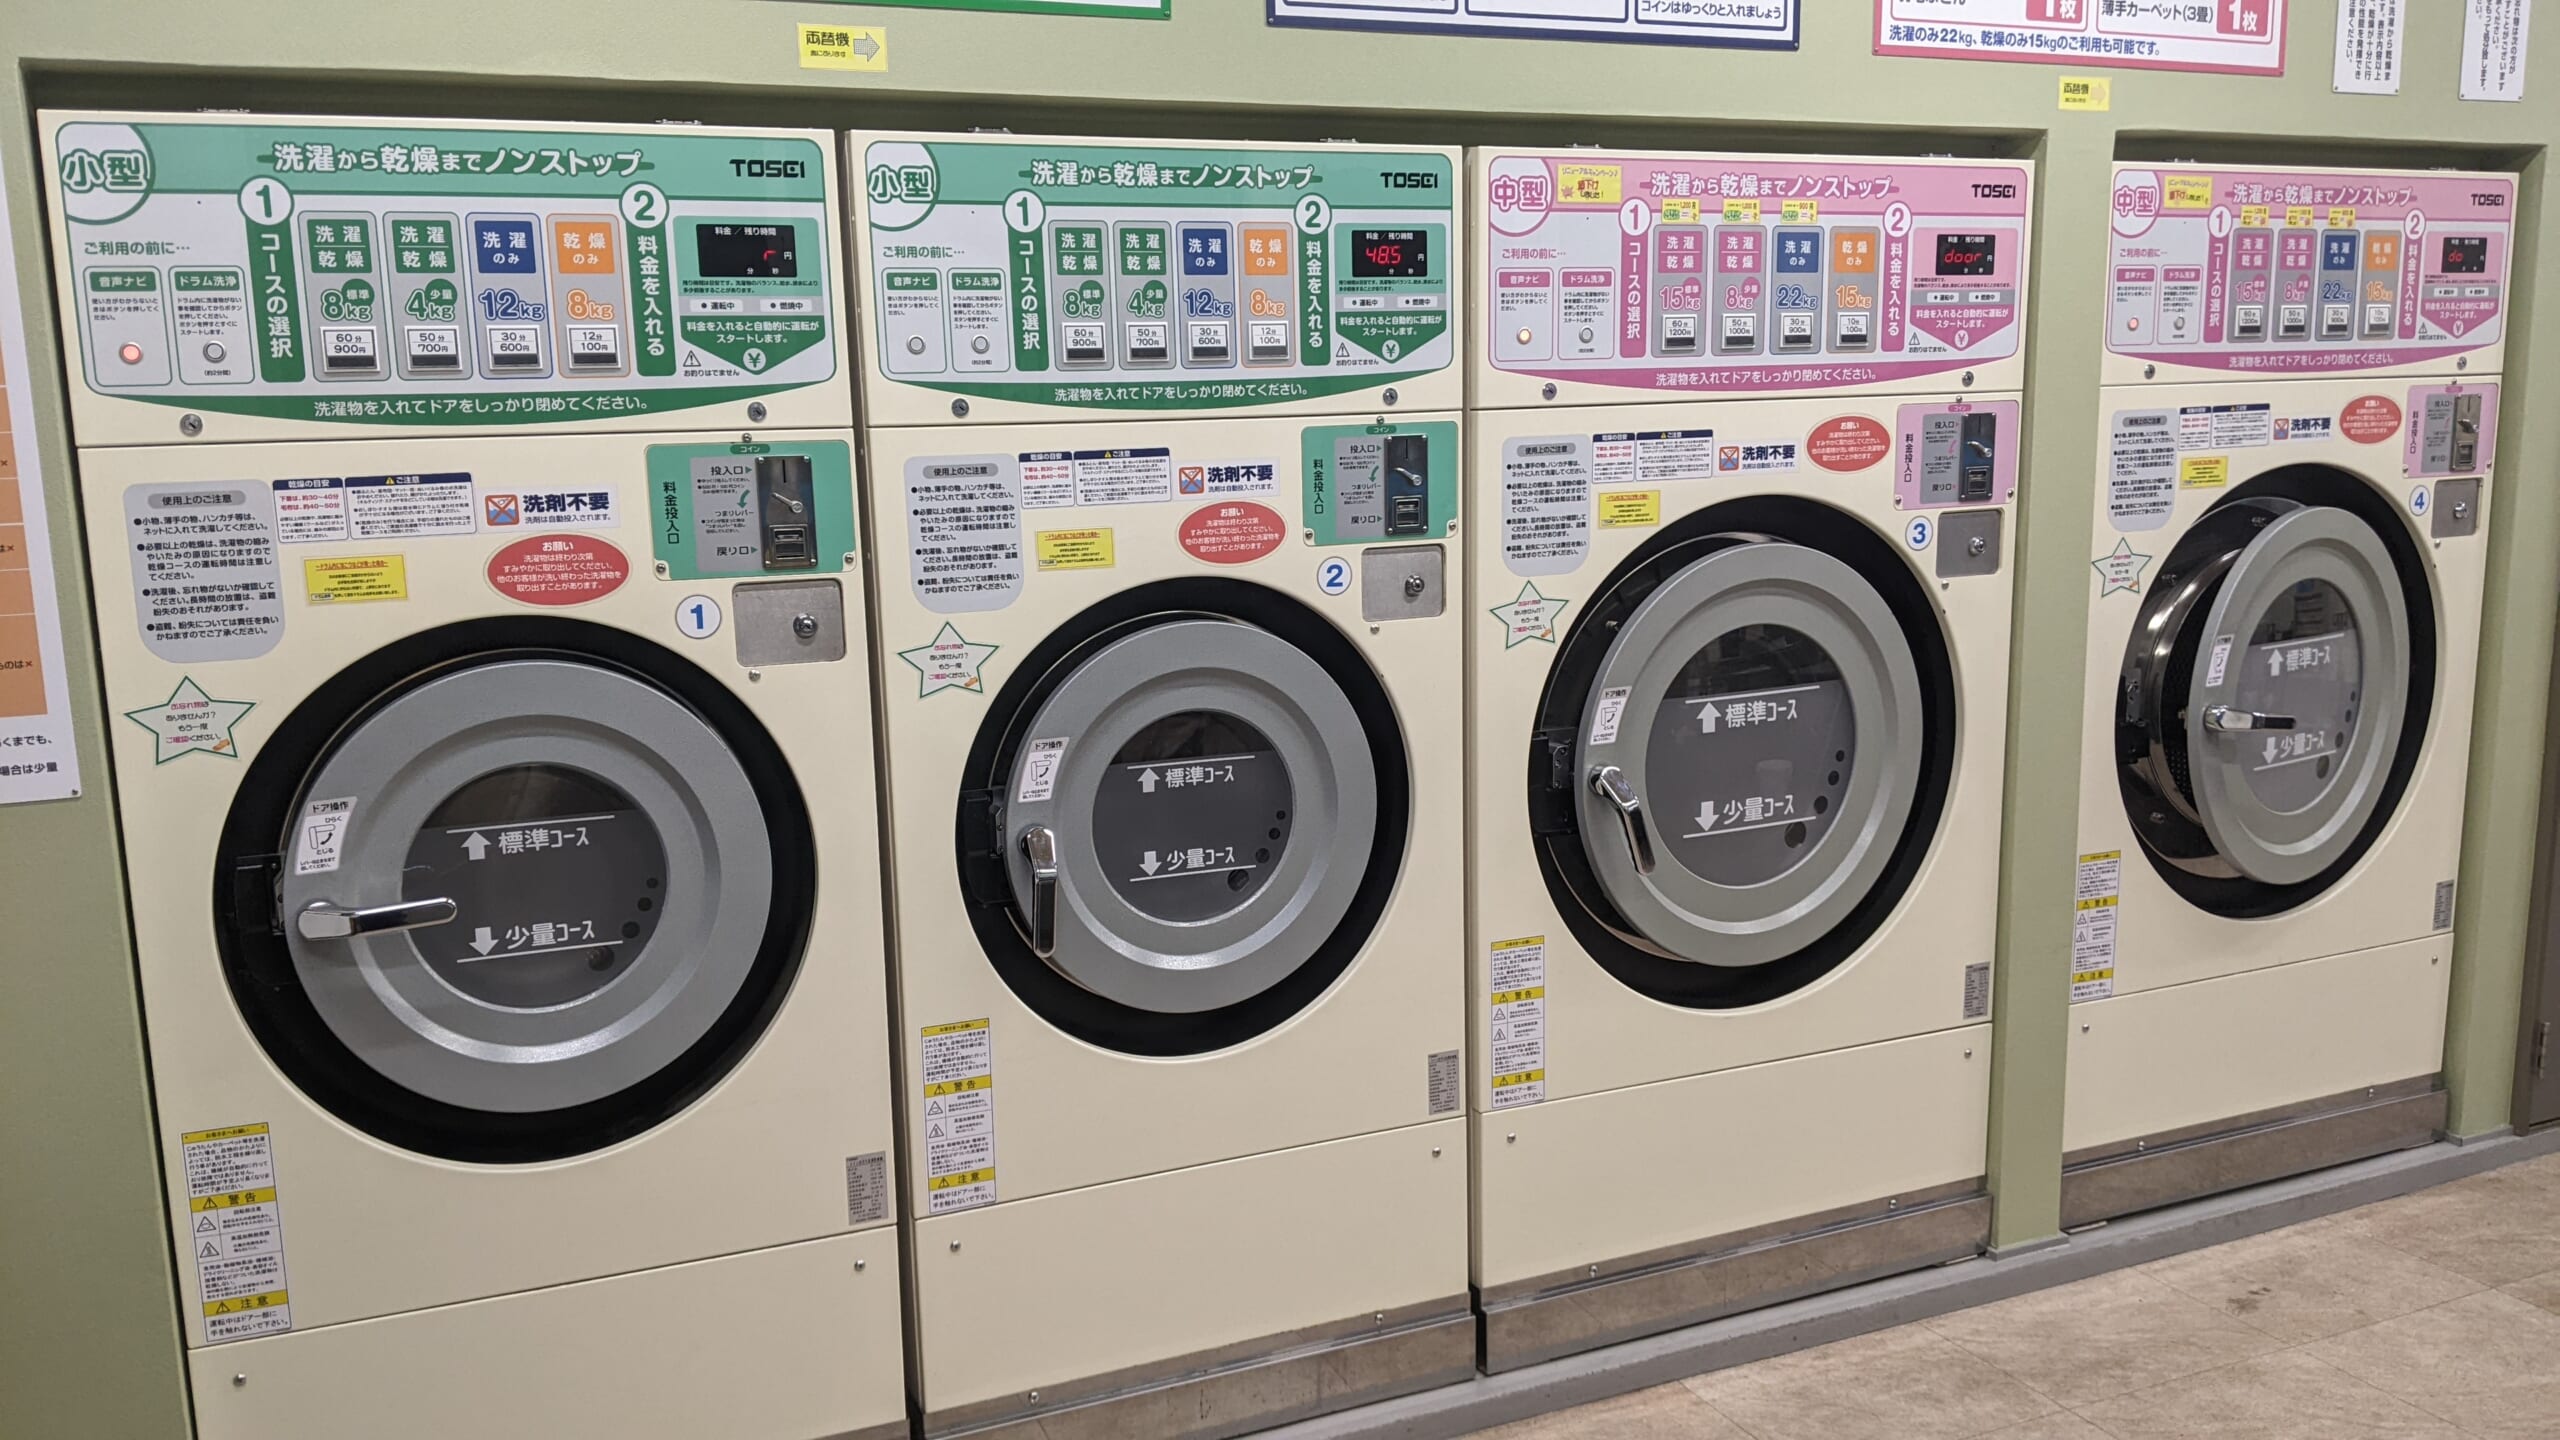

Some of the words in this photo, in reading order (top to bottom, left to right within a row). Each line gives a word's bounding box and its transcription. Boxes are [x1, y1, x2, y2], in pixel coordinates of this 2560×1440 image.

[1642, 1, 1781, 19] コインはゆっくりと入れましょう
[806, 30, 849, 47] 両替機
[1890, 25, 2160, 56] 洗濯のみ22kg、乾燥のみ15kgのご利用も可能です。
[273, 142, 642, 177] 洗濯から乾燥までノンストップ
[730, 159, 806, 178] TOSEI
[62, 150, 147, 192] 小型
[1031, 160, 1315, 189] 洗濯から乾燥までノンストップ
[869, 165, 934, 202] 小型
[1381, 172, 1438, 189] TOSEI
[1651, 172, 1893, 198] 洗濯から乾燥までノンストップ
[1491, 175, 1549, 212] 中型
[1972, 184, 2016, 199] TOSEI
[2232, 184, 2412, 207] 洗濯から乾燥までノンストップ
[2471, 194, 2504, 206] TOSEI
[2115, 185, 2156, 217] 中型
[315, 225, 363, 244] 洗濯
[400, 225, 446, 244] 洗濯
[482, 231, 528, 249] 洗濯
[563, 232, 606, 249] 乾燥
[1061, 233, 1097, 249] 洗濯
[1126, 233, 1160, 249] 洗濯
[1667, 236, 1694, 249] 洗濯
[1727, 236, 1754, 249] 洗濯
[1188, 238, 1222, 253] 洗濯
[1784, 240, 1811, 253] 洗濯
[318, 250, 365, 268] 乾燥
[402, 250, 448, 268] 乾燥
[492, 253, 520, 265] のみ
[572, 253, 600, 265] のみ
[784, 252, 792, 260] 円
[1062, 256, 1098, 270] 乾燥
[1126, 256, 1161, 270] 乾燥
[99, 276, 147, 287] 音声ナビ
[180, 276, 237, 286] ドラム洗浄
[893, 276, 931, 286] 音声ナビ
[954, 276, 1000, 286] ドラム洗浄
[1888, 243, 1902, 336] 料金を入れる
[2209, 243, 2224, 327] コースの選択
[2403, 244, 2418, 326] 料金を入れる
[260, 232, 293, 359] コースの選択
[346, 288, 370, 299] 標準
[430, 288, 453, 299] 少量
[637, 235, 665, 357] 料金を入れる
[1019, 239, 1040, 350] コースの選択
[1306, 241, 1323, 348] 料金を入れる
[1626, 242, 1641, 339] コースの選択
[1660, 286, 1701, 310] 15kg
[1725, 286, 1752, 309] 8kg
[1777, 285, 1818, 309] 22kg
[1836, 286, 1872, 308] 15kg
[321, 289, 373, 322] 8kg
[405, 289, 455, 321] 4kg
[479, 288, 545, 321] 12kg
[567, 289, 615, 320] 8kg
[710, 302, 735, 310] 運転中
[1063, 289, 1102, 318] 8kg
[1128, 289, 1165, 318] 4kg
[1183, 289, 1233, 317] 12kg
[1250, 289, 1285, 317] 8kg
[687, 321, 819, 332] 料金を入れると自動的に運転が
[580, 341, 609, 352] 100円
[716, 333, 788, 344] スタートします。
[1072, 338, 1097, 347] 900円
[1136, 337, 1160, 346] 700円
[1198, 336, 1221, 345] 600円
[1259, 336, 1281, 345] 100円
[334, 344, 366, 355] 900円
[418, 343, 449, 354] 700円
[500, 343, 530, 353] 600円
[1656, 368, 1876, 386] 洗濯物を入れてドアをしっかり閉めてください。
[1054, 383, 1308, 402] 洗濯物を入れてドアをしっかり閉めてください。
[314, 396, 649, 417] 洗濯物を入れてドアをしっかり閉めてください。
[1935, 421, 1954, 429] 投入口
[2291, 417, 2331, 431] 洗剤不要
[1350, 445, 1375, 453] 投入口
[1742, 445, 1796, 462] 洗剤不要
[1904, 433, 1913, 482] 料金投入口
[711, 466, 743, 476] 投入口
[934, 466, 988, 476] 使用上のご注意
[1207, 465, 1273, 483] 洗剤不要
[288, 480, 330, 488] 乾燥の目安
[396, 476, 420, 485] ご注意
[1313, 459, 1324, 514] 料金投入口
[162, 494, 233, 506] 使用上のご注意
[523, 492, 609, 513] 洗剤不要
[2414, 492, 2425, 509] 4
[525, 514, 611, 524] 洗剤は自動投入されます。
[662, 481, 680, 545] 料金投入口
[1220, 508, 1244, 517] お願い
[144, 523, 268, 535] ネットに入れて洗濯してください。
[1913, 523, 1926, 544] 3
[542, 541, 574, 552] お願い
[717, 546, 749, 556] 戻り口
[149, 572, 195, 581] てください。
[1326, 564, 1343, 587] 2
[690, 604, 704, 630] 1
[2286, 646, 2330, 671] 標準コース
[1725, 699, 1798, 729] 標準コース
[178, 723, 209, 732] もう一度
[2280, 731, 2324, 758] 少量コース
[1165, 765, 1234, 788] 標準コース
[312, 801, 349, 813] ドア操作
[1723, 795, 1794, 825] 少量コース
[498, 827, 590, 855] 標準コース
[1167, 847, 1235, 871] 少量コース
[505, 920, 595, 950] 少量コース
[240, 1295, 268, 1309] 注意
